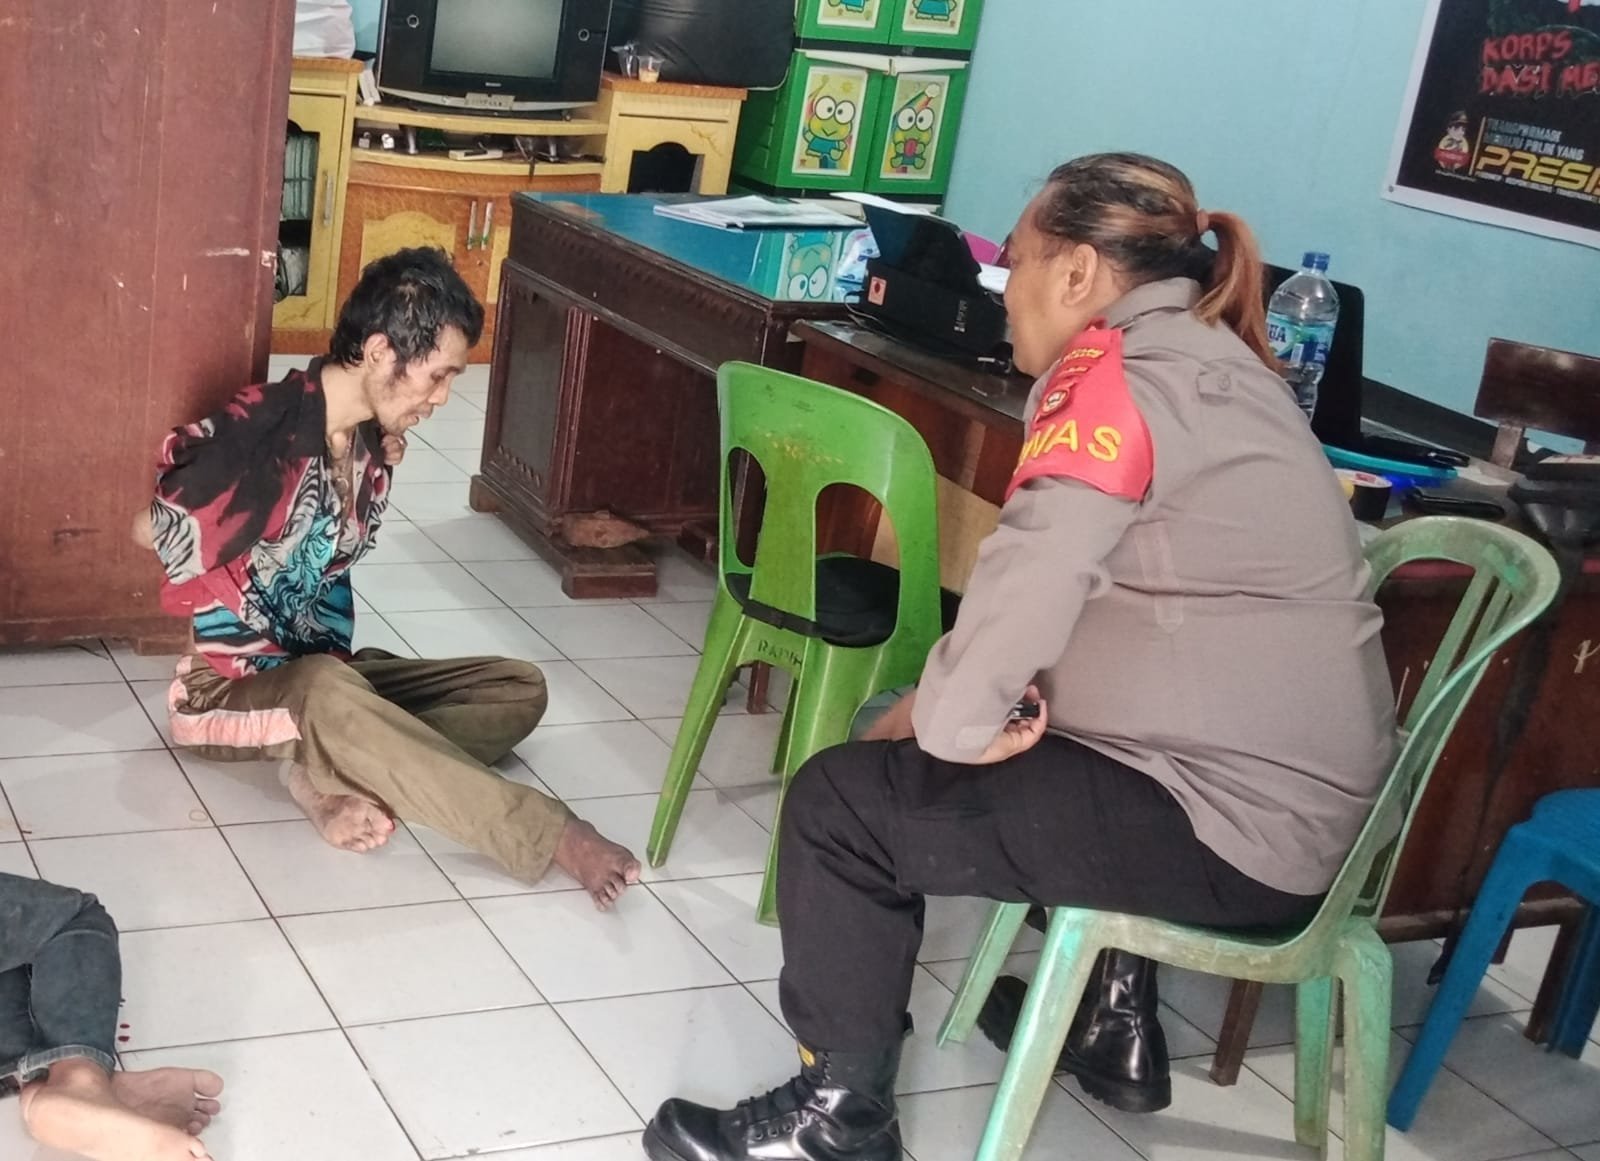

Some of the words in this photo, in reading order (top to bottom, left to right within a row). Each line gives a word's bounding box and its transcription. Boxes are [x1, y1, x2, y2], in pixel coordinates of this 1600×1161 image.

[1482, 30, 1573, 64] KORPS
[1475, 145, 1600, 195] PRESI
[1556, 144, 1585, 161] YANG
[1014, 419, 1122, 475] WAS
